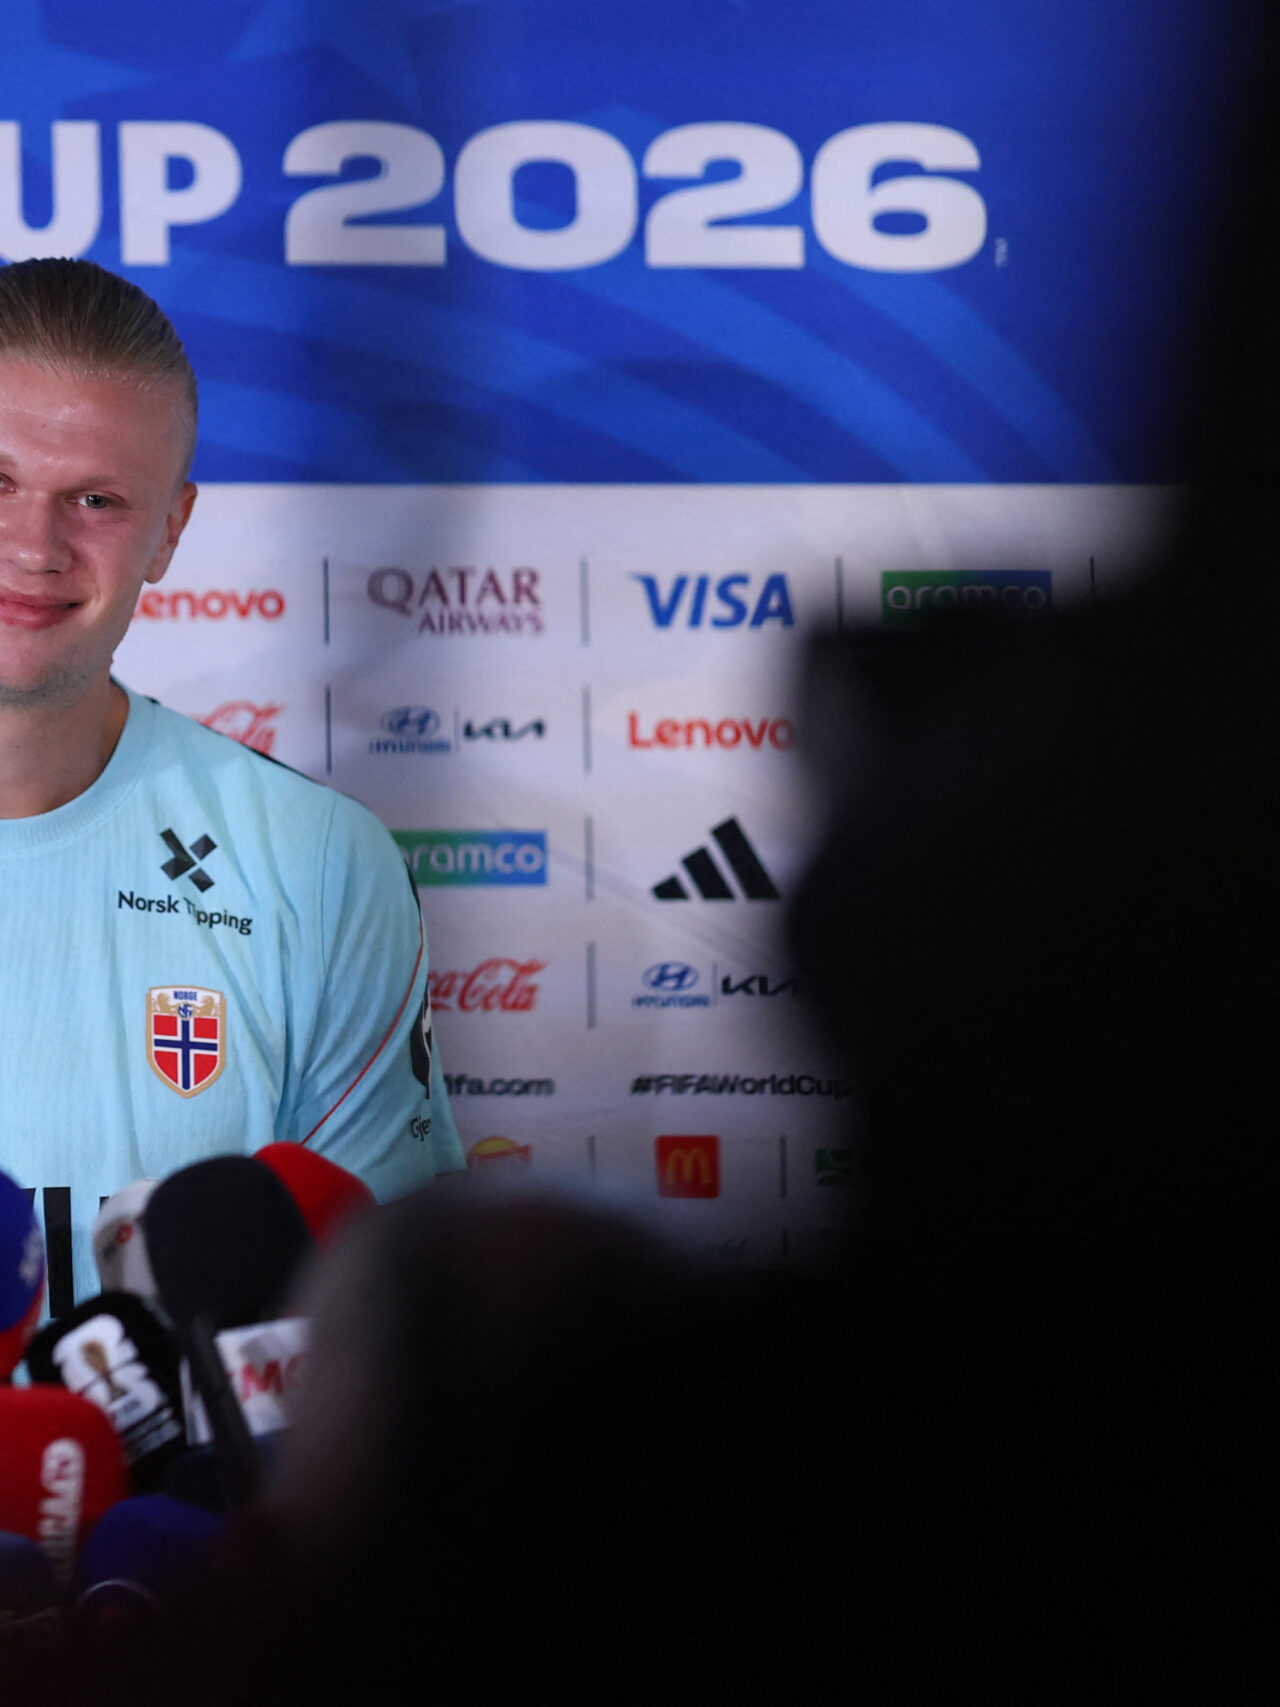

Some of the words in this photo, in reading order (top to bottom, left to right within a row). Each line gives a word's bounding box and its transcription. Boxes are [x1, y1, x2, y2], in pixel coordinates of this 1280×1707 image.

[283, 118, 988, 273] 2026
[132, 588, 286, 621] enovo
[367, 567, 541, 616] QATAR
[630, 573, 795, 628] VISA
[419, 613, 543, 635] AIRWAYS
[629, 712, 798, 751] Lenovo
[117, 890, 180, 914] Norsk
[629, 1073, 853, 1099] #FIFAWorldCup
